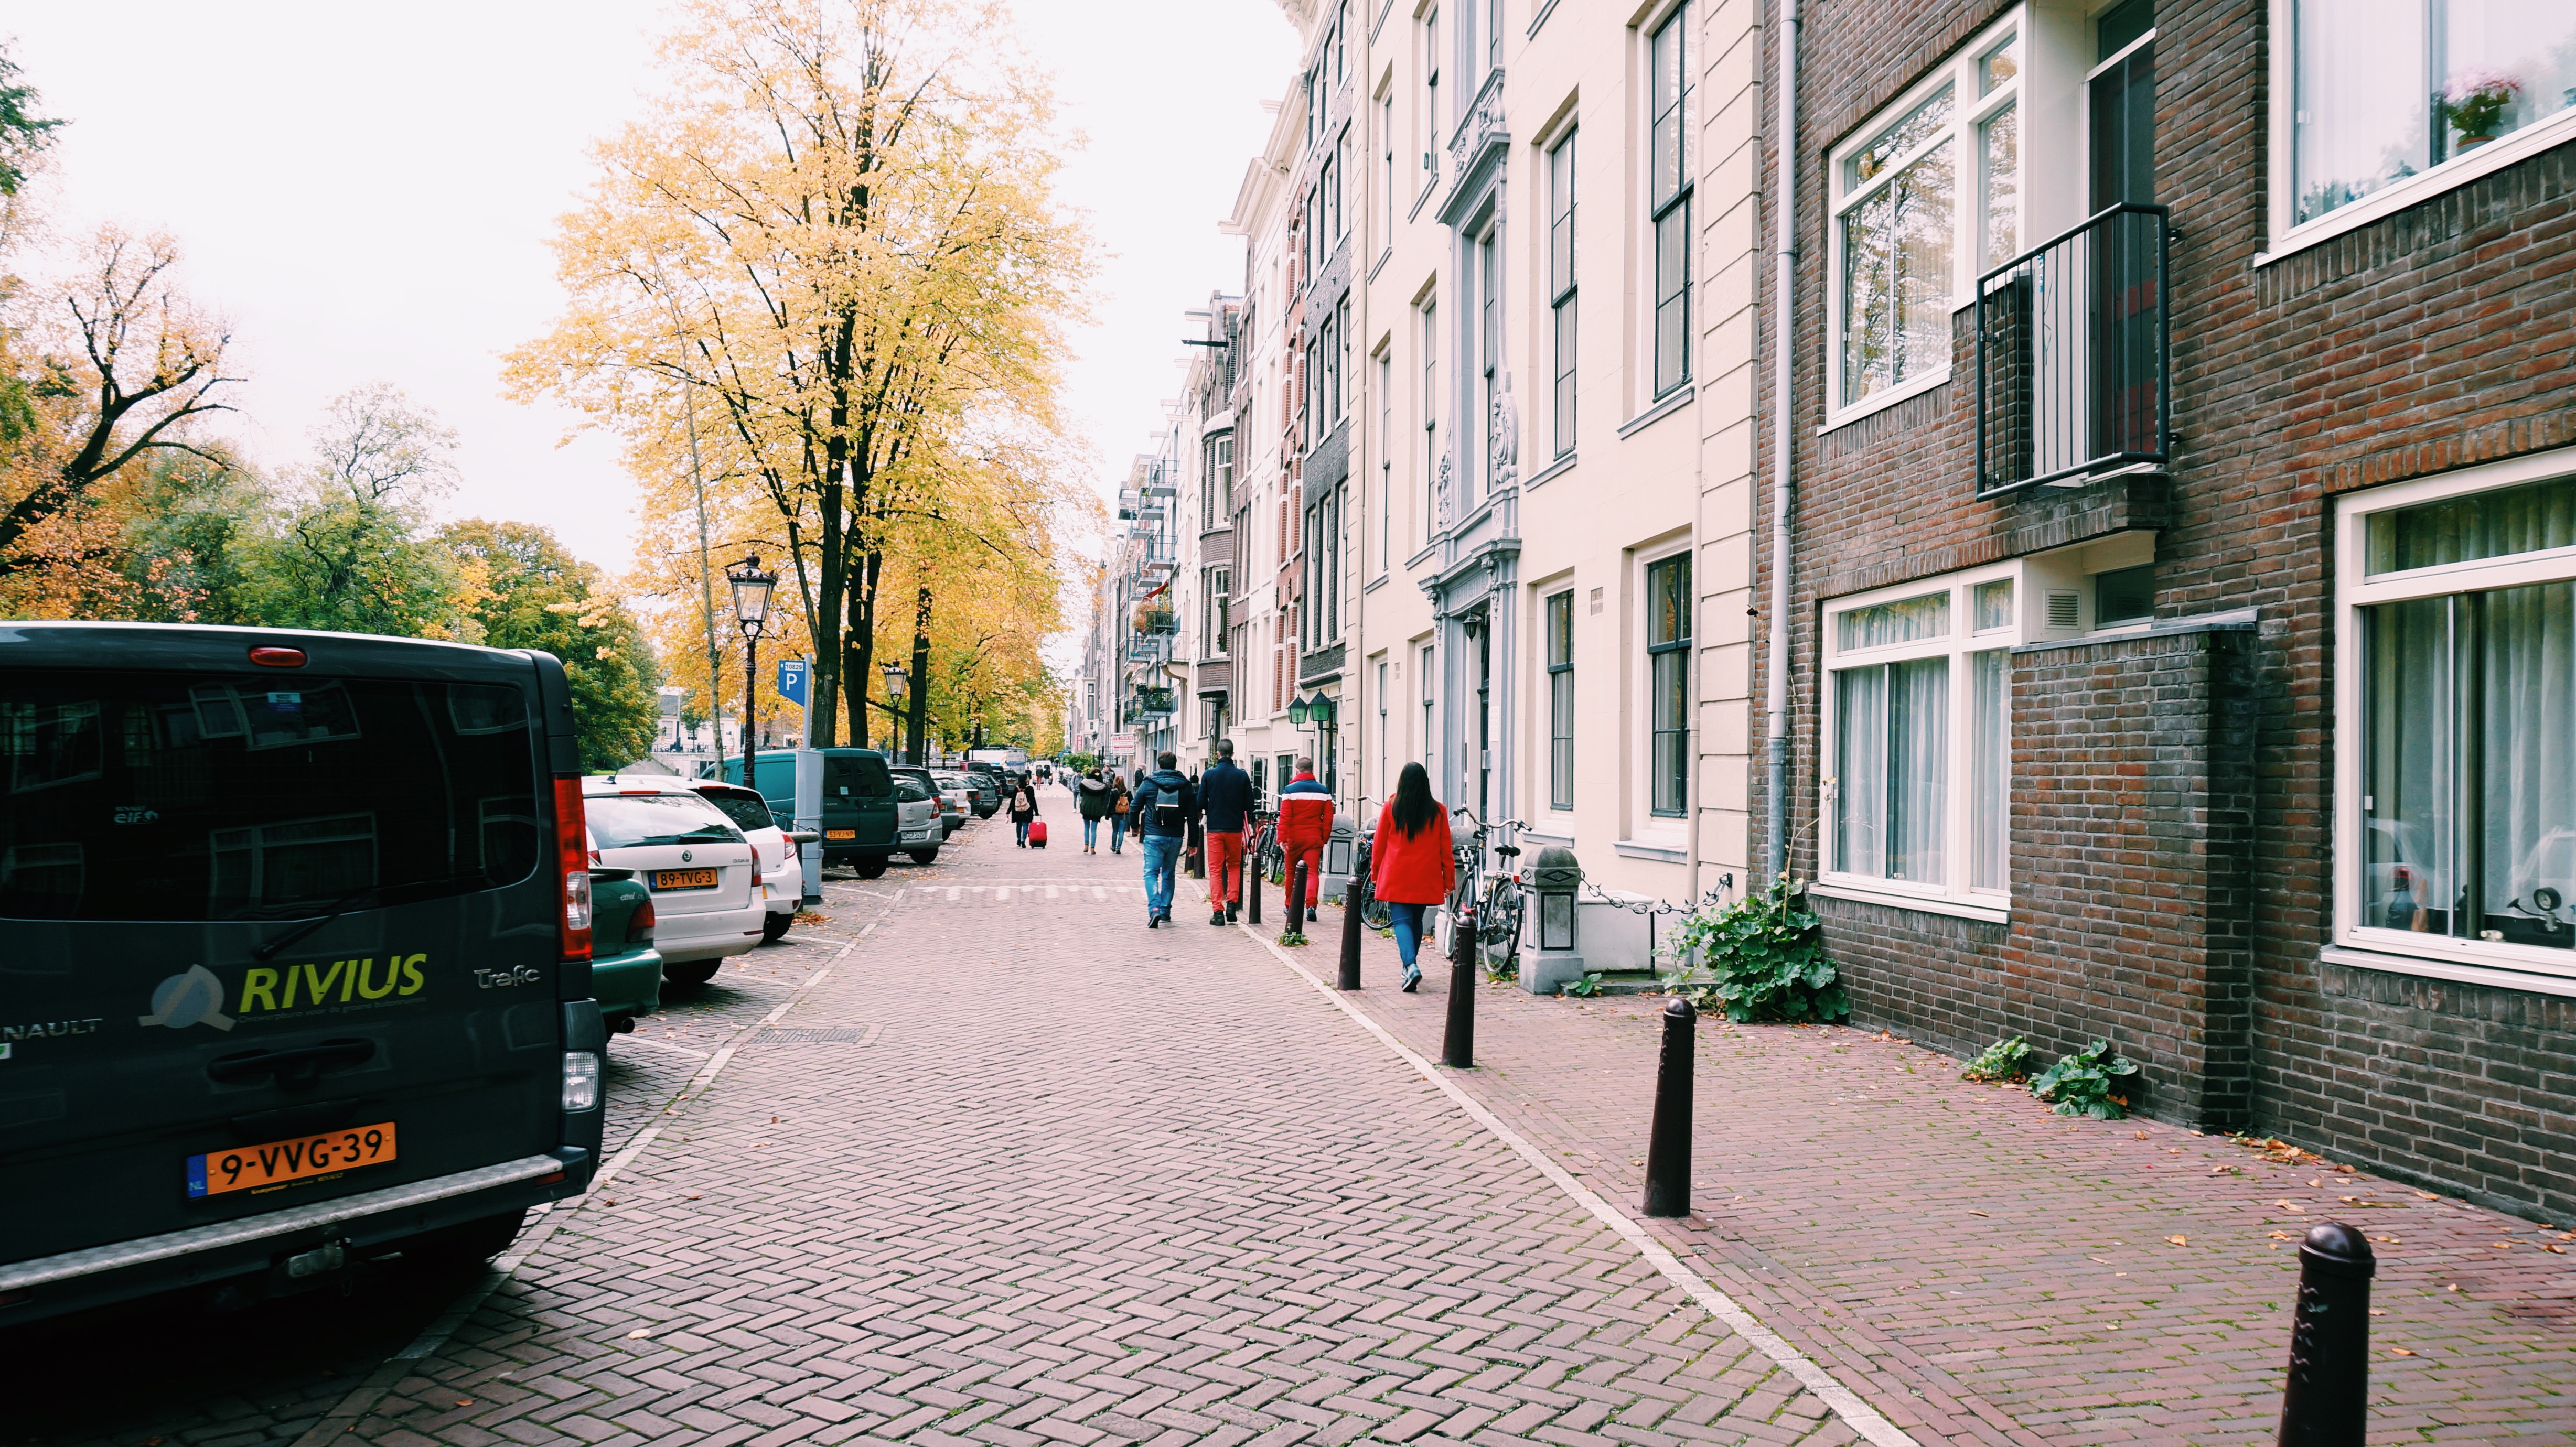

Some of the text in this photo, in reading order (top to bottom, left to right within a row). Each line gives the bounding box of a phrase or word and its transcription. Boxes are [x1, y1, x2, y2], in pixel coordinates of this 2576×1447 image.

[786, 673, 797, 690] P
[113, 812, 143, 823] elf
[660, 871, 712, 886] 89-TVG-3
[239, 953, 427, 1013] RIVIUS
[473, 965, 541, 989] Trafic
[341, 1002, 372, 1014] groene
[0, 1018, 104, 1041] NAULT
[220, 1129, 383, 1185] 9-VVG-39
[188, 1180, 206, 1192] NL
